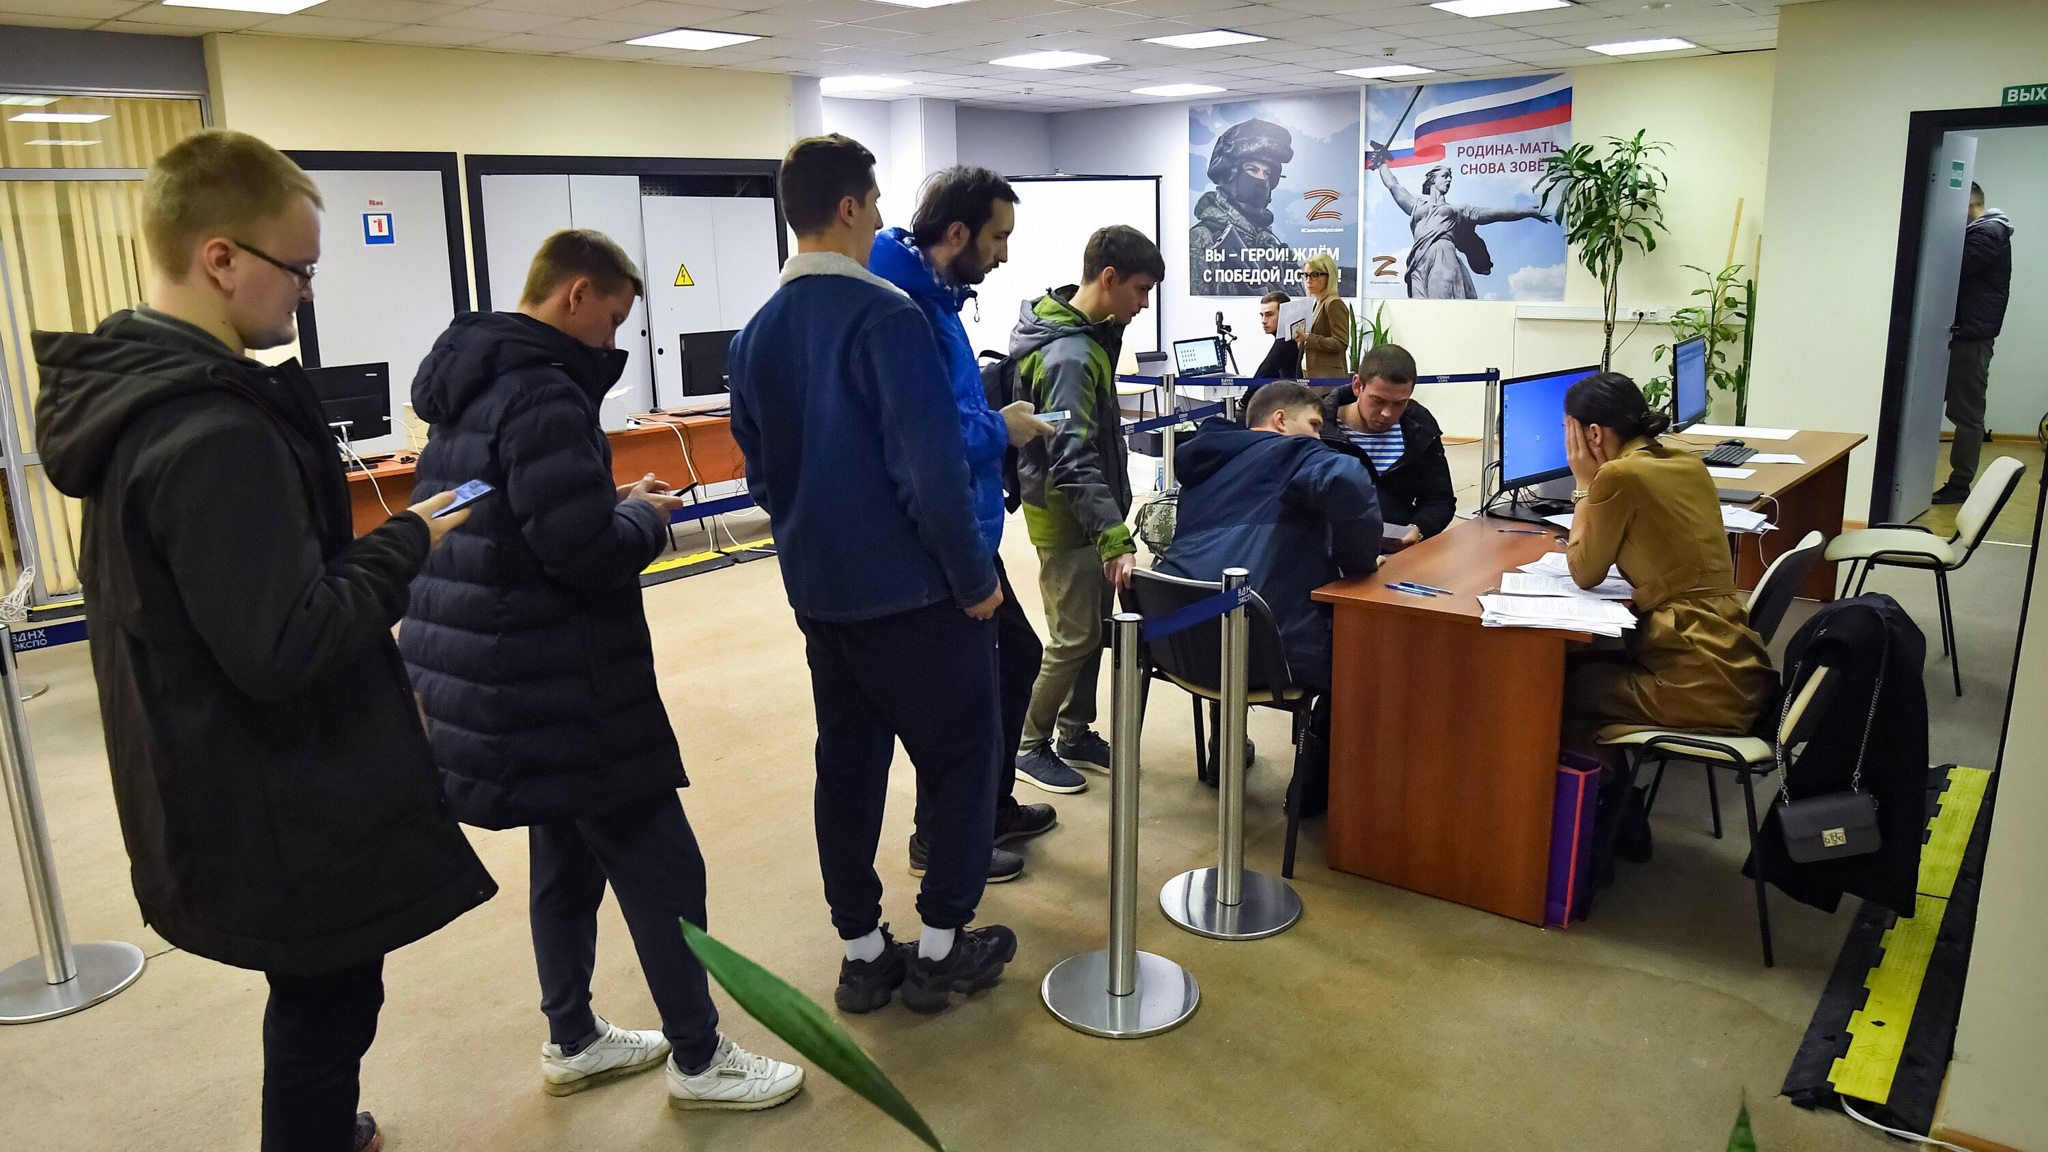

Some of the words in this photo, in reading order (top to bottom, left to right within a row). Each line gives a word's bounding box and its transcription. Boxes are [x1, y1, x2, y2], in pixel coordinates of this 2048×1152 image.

[2007, 87, 2048, 102] ВЫХ
[1457, 141, 1559, 159] РОДИНА-МАТЬ
[1460, 162, 1506, 175] СНОВА
[1205, 248, 1225, 262] ВЫ
[1240, 247, 1289, 262] ГЕРОИ!
[1203, 269, 1212, 283] С
[1215, 266, 1280, 285] ПОБЕДОЙ
